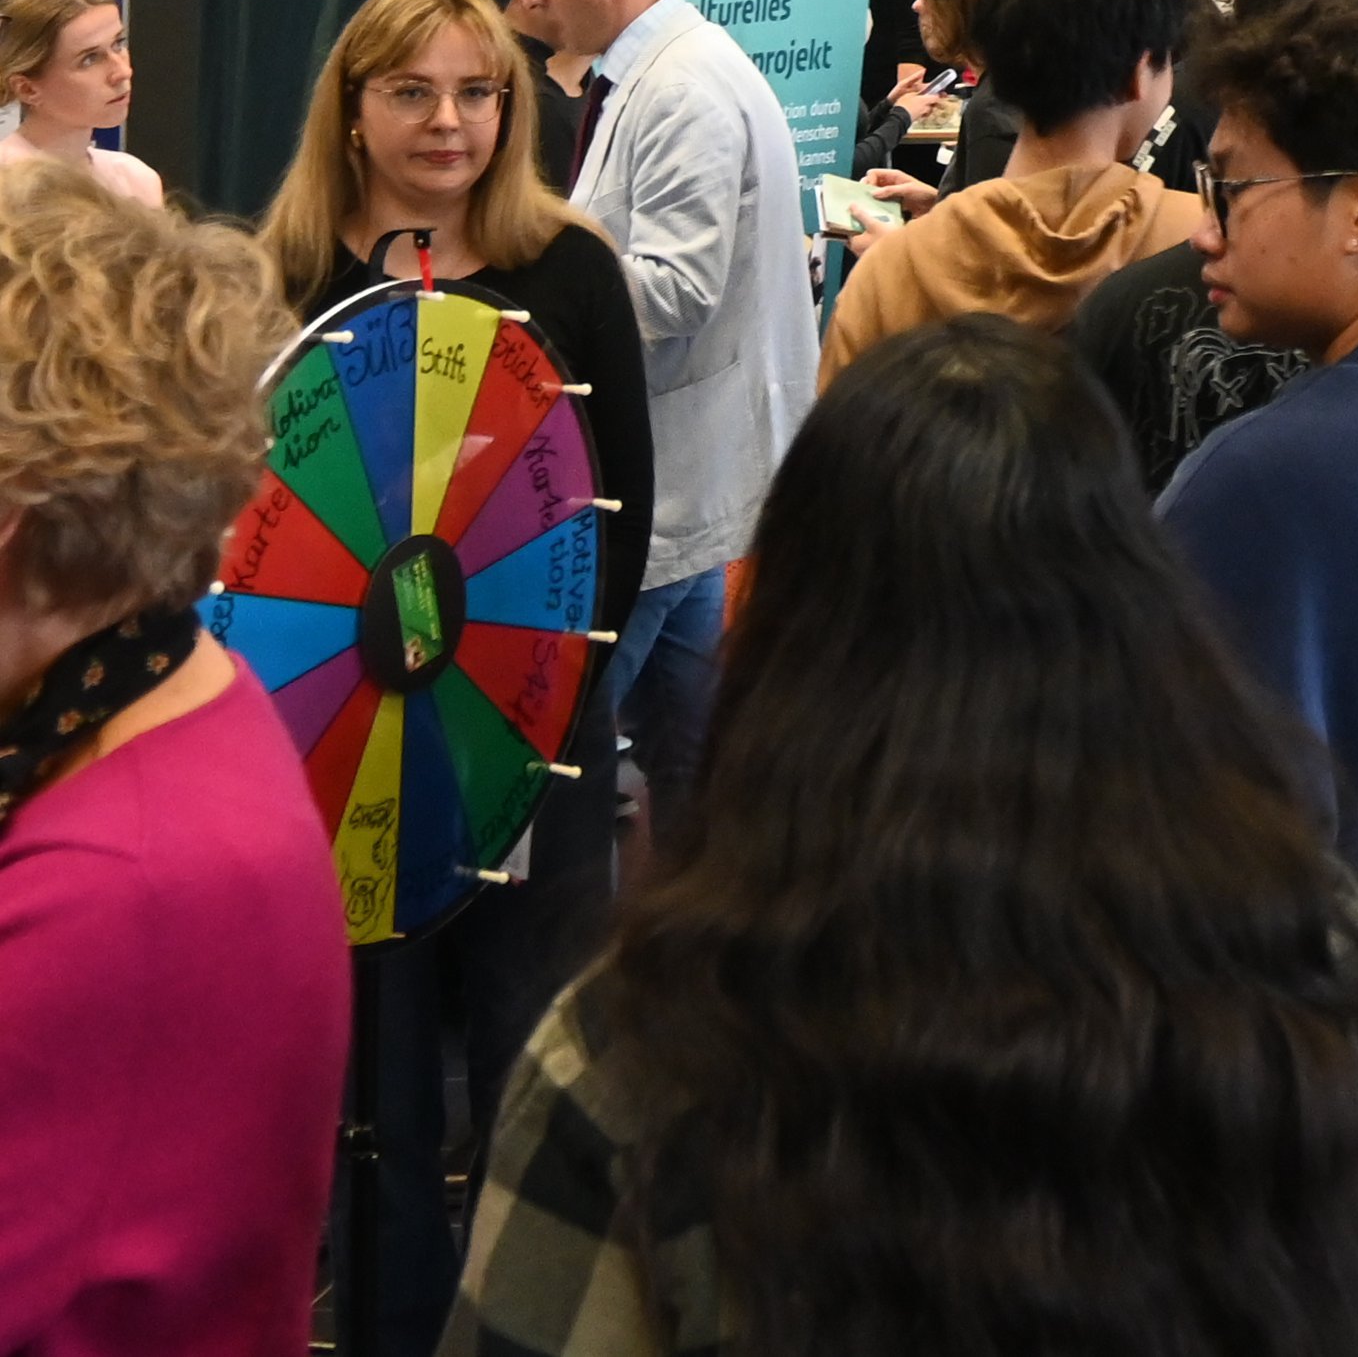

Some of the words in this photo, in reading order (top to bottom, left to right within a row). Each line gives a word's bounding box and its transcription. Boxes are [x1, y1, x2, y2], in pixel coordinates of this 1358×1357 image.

[747, 38, 833, 80] projekt
[784, 102, 807, 119] tion
[810, 99, 841, 116] durch
[800, 149, 836, 166] kannst
[420, 337, 466, 384] Stift
[229, 488, 292, 591] Karte
